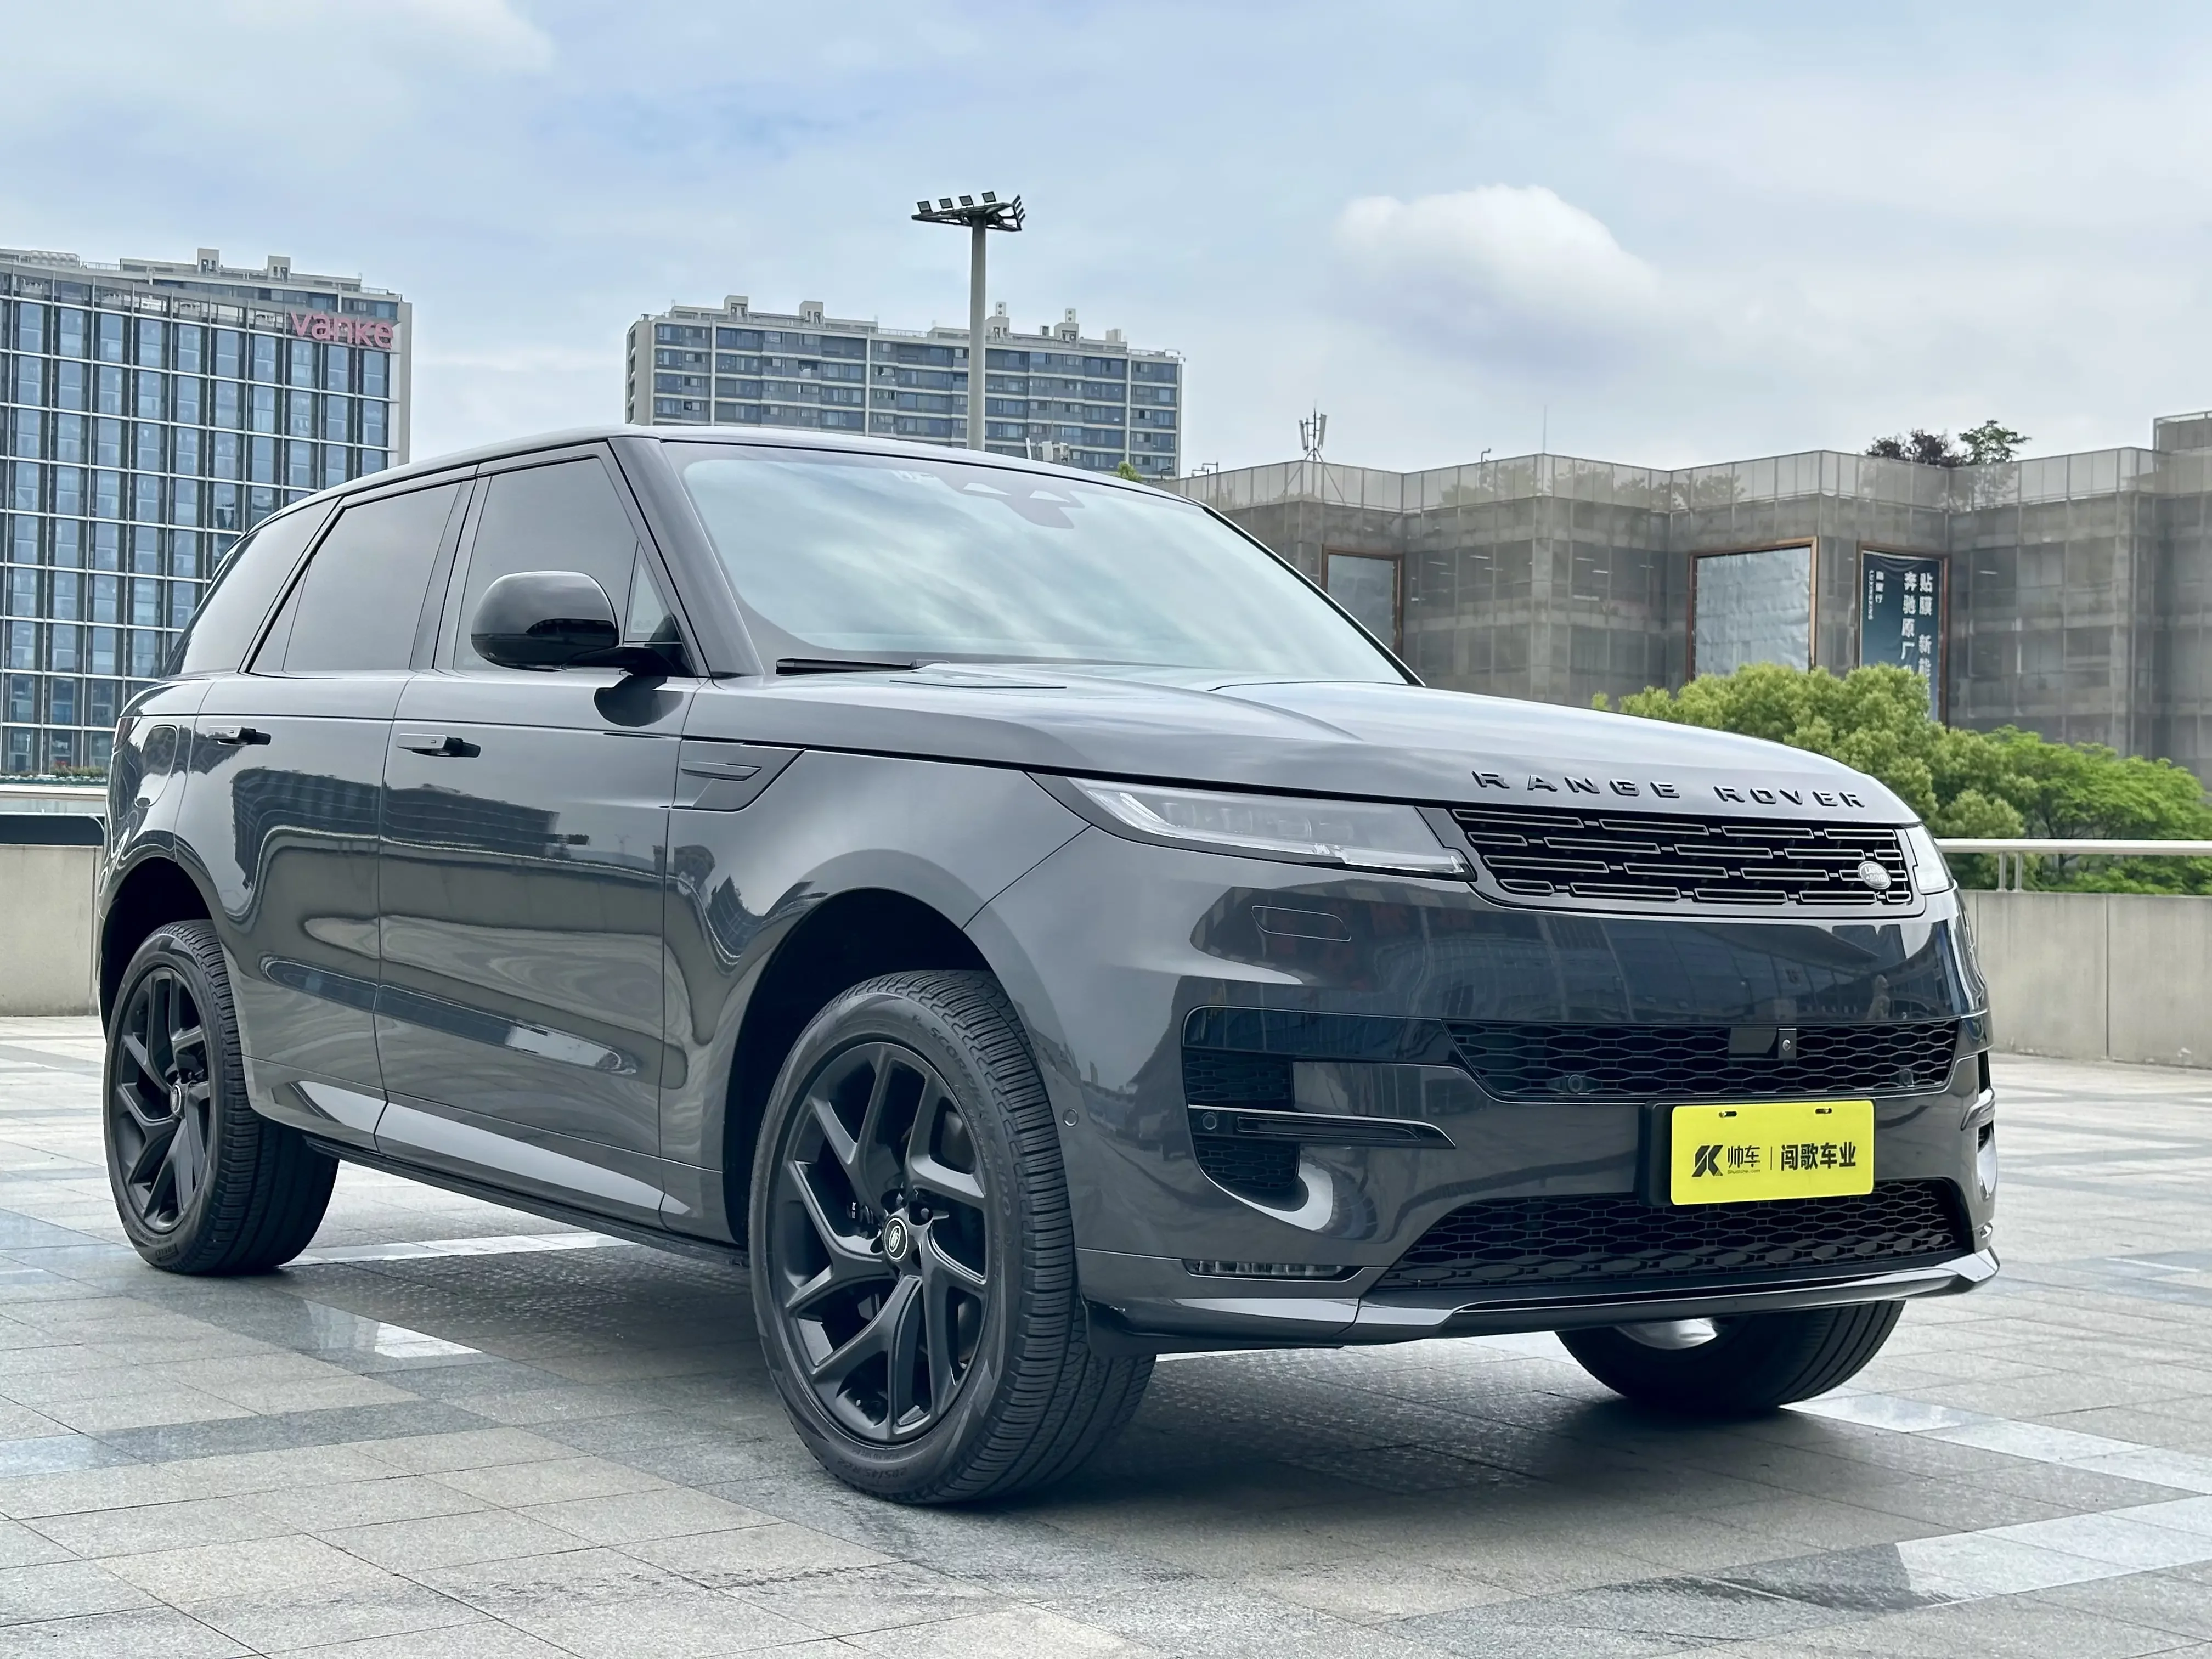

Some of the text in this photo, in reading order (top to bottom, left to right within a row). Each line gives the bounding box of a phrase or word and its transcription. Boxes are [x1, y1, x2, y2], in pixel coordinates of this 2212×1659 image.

[290, 310, 393, 349] vanke
[1900, 571, 1917, 673] 奔驰原厂
[1918, 634, 1933, 699] 新能
[1471, 770, 1866, 808] RANGE ROVER
[1728, 1141, 1856, 1171] 帅车 闯歌车业
